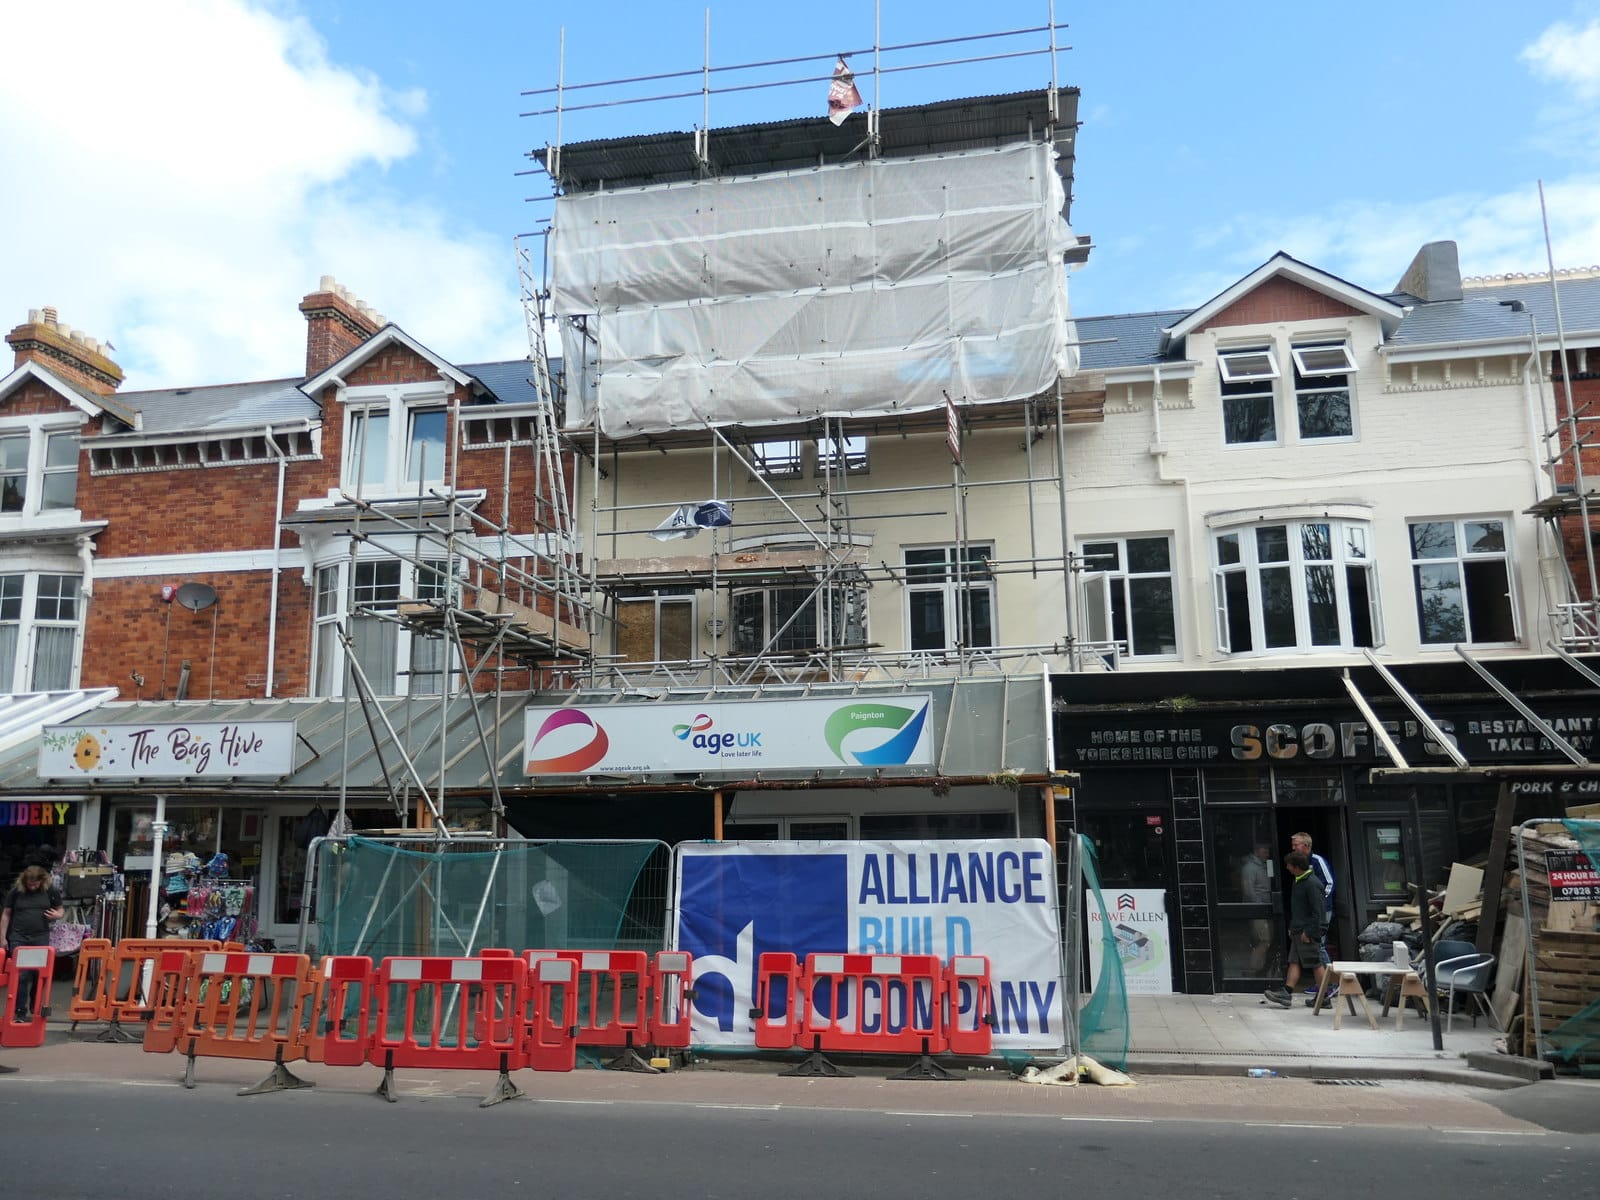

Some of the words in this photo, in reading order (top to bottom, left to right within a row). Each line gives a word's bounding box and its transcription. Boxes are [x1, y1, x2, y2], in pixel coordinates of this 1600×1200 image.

[850, 710, 885, 721] Paignton
[1091, 730, 1140, 743] HOME
[1143, 729, 1164, 743] OF
[1167, 728, 1202, 742] THE
[128, 728, 160, 770] The
[167, 727, 212, 774] Bag
[220, 725, 263, 767] Hive
[692, 733, 735, 755] age
[737, 732, 762, 747] UK
[1487, 737, 1534, 751] TAKE
[1076, 746, 1174, 761] YORKSHIRE
[1176, 745, 1219, 760] CHIP
[1511, 782, 1553, 793] PORK
[1561, 781, 1573, 791] &
[858, 850, 1045, 905] ALLIANCE
[1563, 872, 1588, 880] HOUR
[1127, 912, 1164, 922] ALLEN
